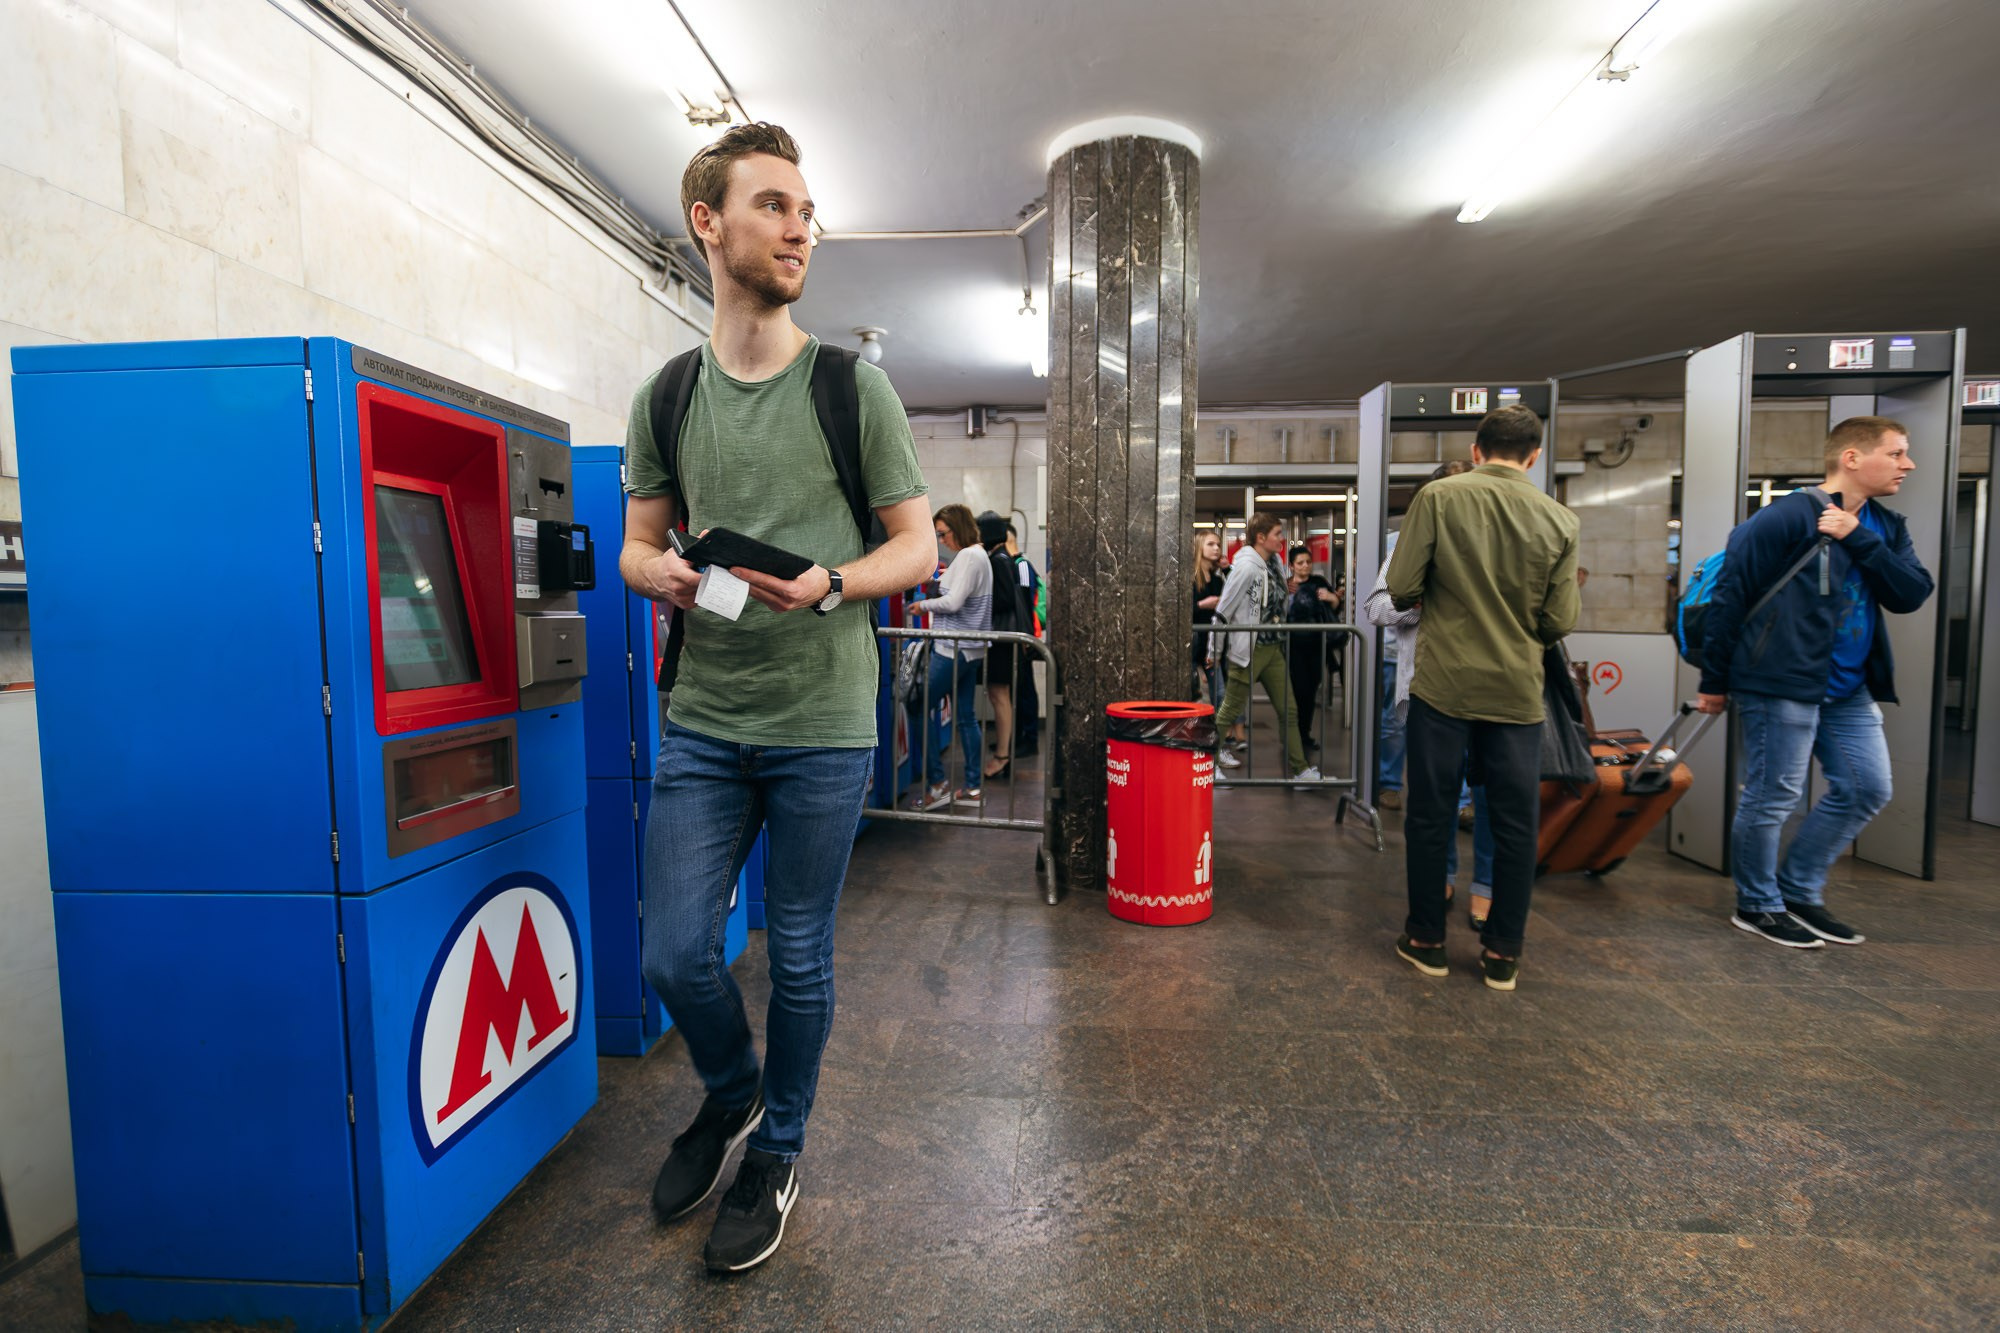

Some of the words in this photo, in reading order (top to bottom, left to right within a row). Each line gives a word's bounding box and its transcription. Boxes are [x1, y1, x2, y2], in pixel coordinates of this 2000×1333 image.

[363, 357, 405, 380] АВТОМАТ
[406, 371, 446, 394] ПРОДАЖИ
[1192, 772, 1214, 789] горо
